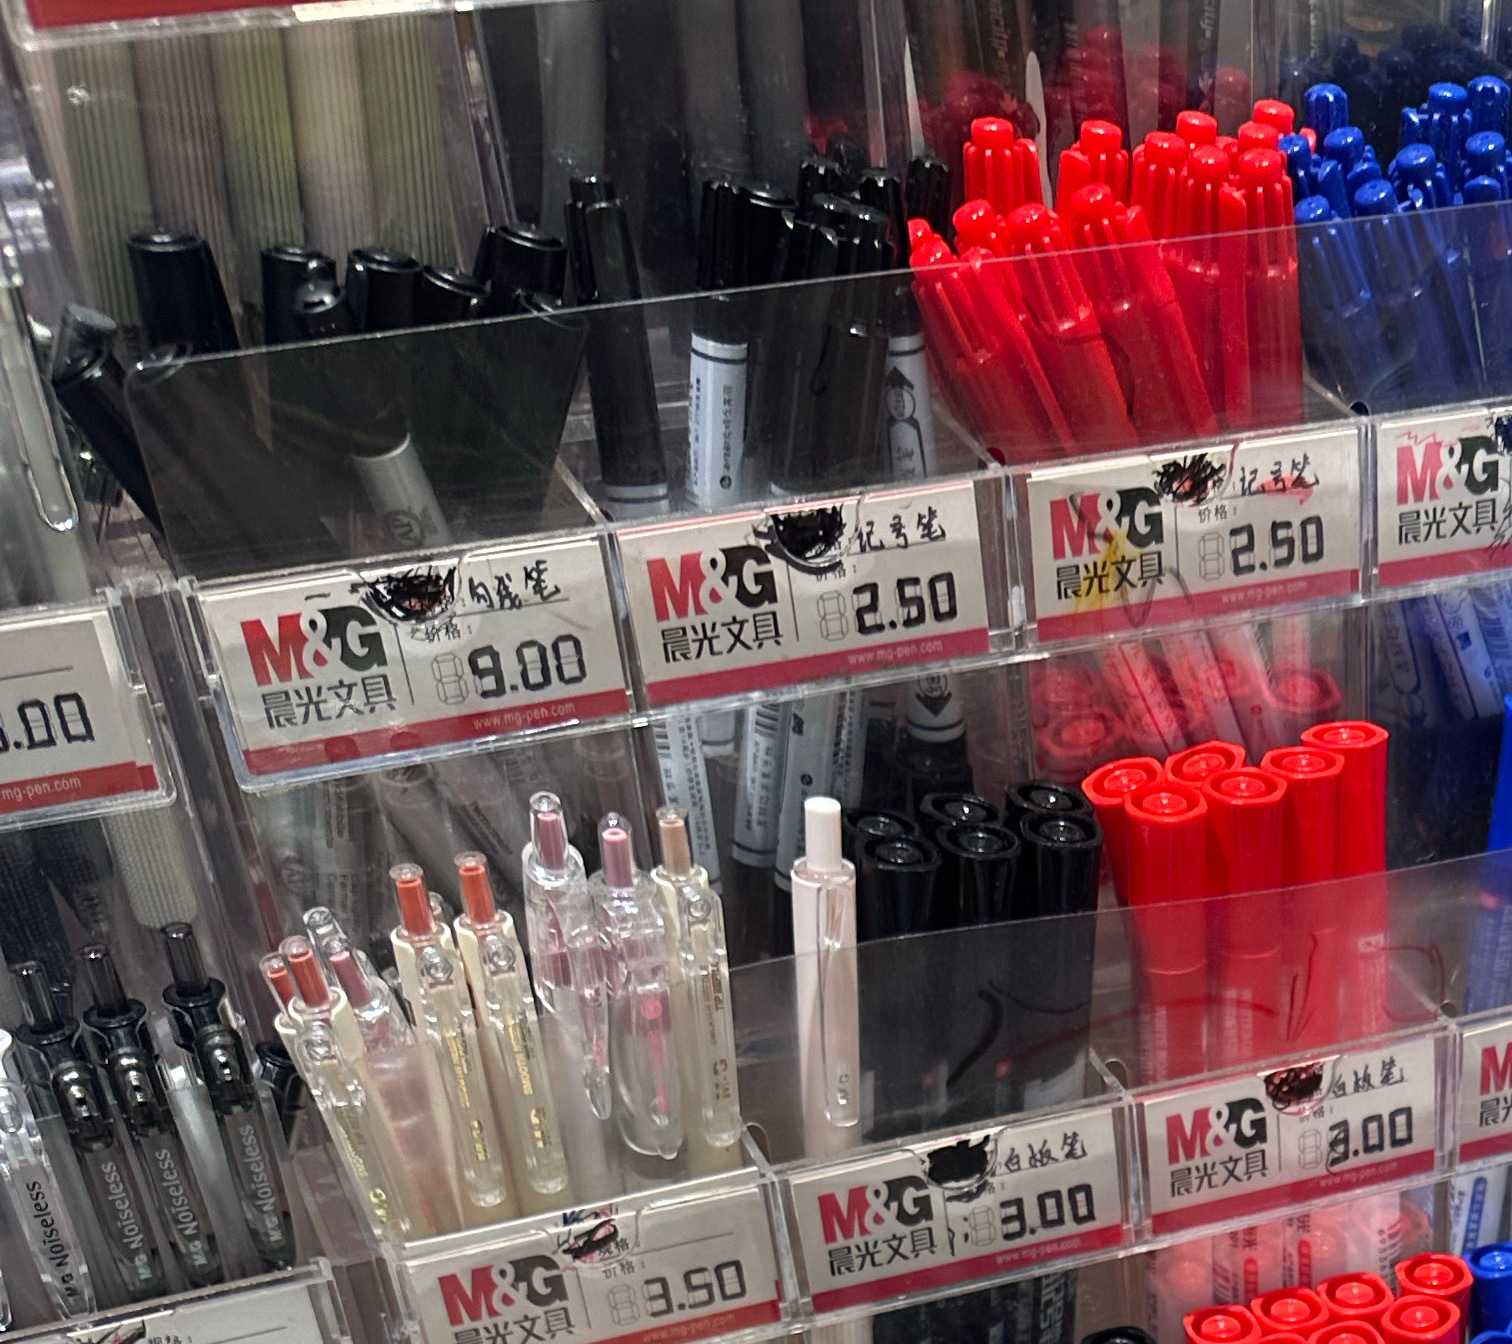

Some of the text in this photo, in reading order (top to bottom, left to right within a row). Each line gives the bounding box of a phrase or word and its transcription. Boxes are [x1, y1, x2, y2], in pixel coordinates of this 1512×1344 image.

[1239, 452, 1320, 497] 记号笔
[1396, 434, 1499, 505] M&G
[858, 506, 947, 553] 记号笔
[1050, 487, 1164, 560] M&G
[1229, 515, 1324, 577] 2.50
[1398, 497, 1499, 545] 晨光文具
[646, 544, 778, 623] M&G
[853, 571, 958, 635] 2.50
[1056, 550, 1164, 600] 晨光文具
[240, 604, 389, 686] M&G
[468, 633, 587, 699] 9.00
[661, 610, 783, 664] 晨光文具
[0, 692, 95, 753] .00
[261, 673, 397, 729] 晨光文具
[473, 702, 576, 731] www.mg-pen.com
[1332, 1056, 1408, 1099] 白板笔
[1004, 1131, 1089, 1174] 白板笔
[1165, 1097, 1267, 1166] M&G
[1329, 1106, 1413, 1168] 3.00
[1170, 1149, 1268, 1198] 晨光文具
[817, 1175, 934, 1245] M&G
[1000, 1184, 1096, 1242] 3.00
[828, 1227, 936, 1277] 晨光文具
[437, 1254, 570, 1327] M&G
[644, 1259, 748, 1318] 3.50
